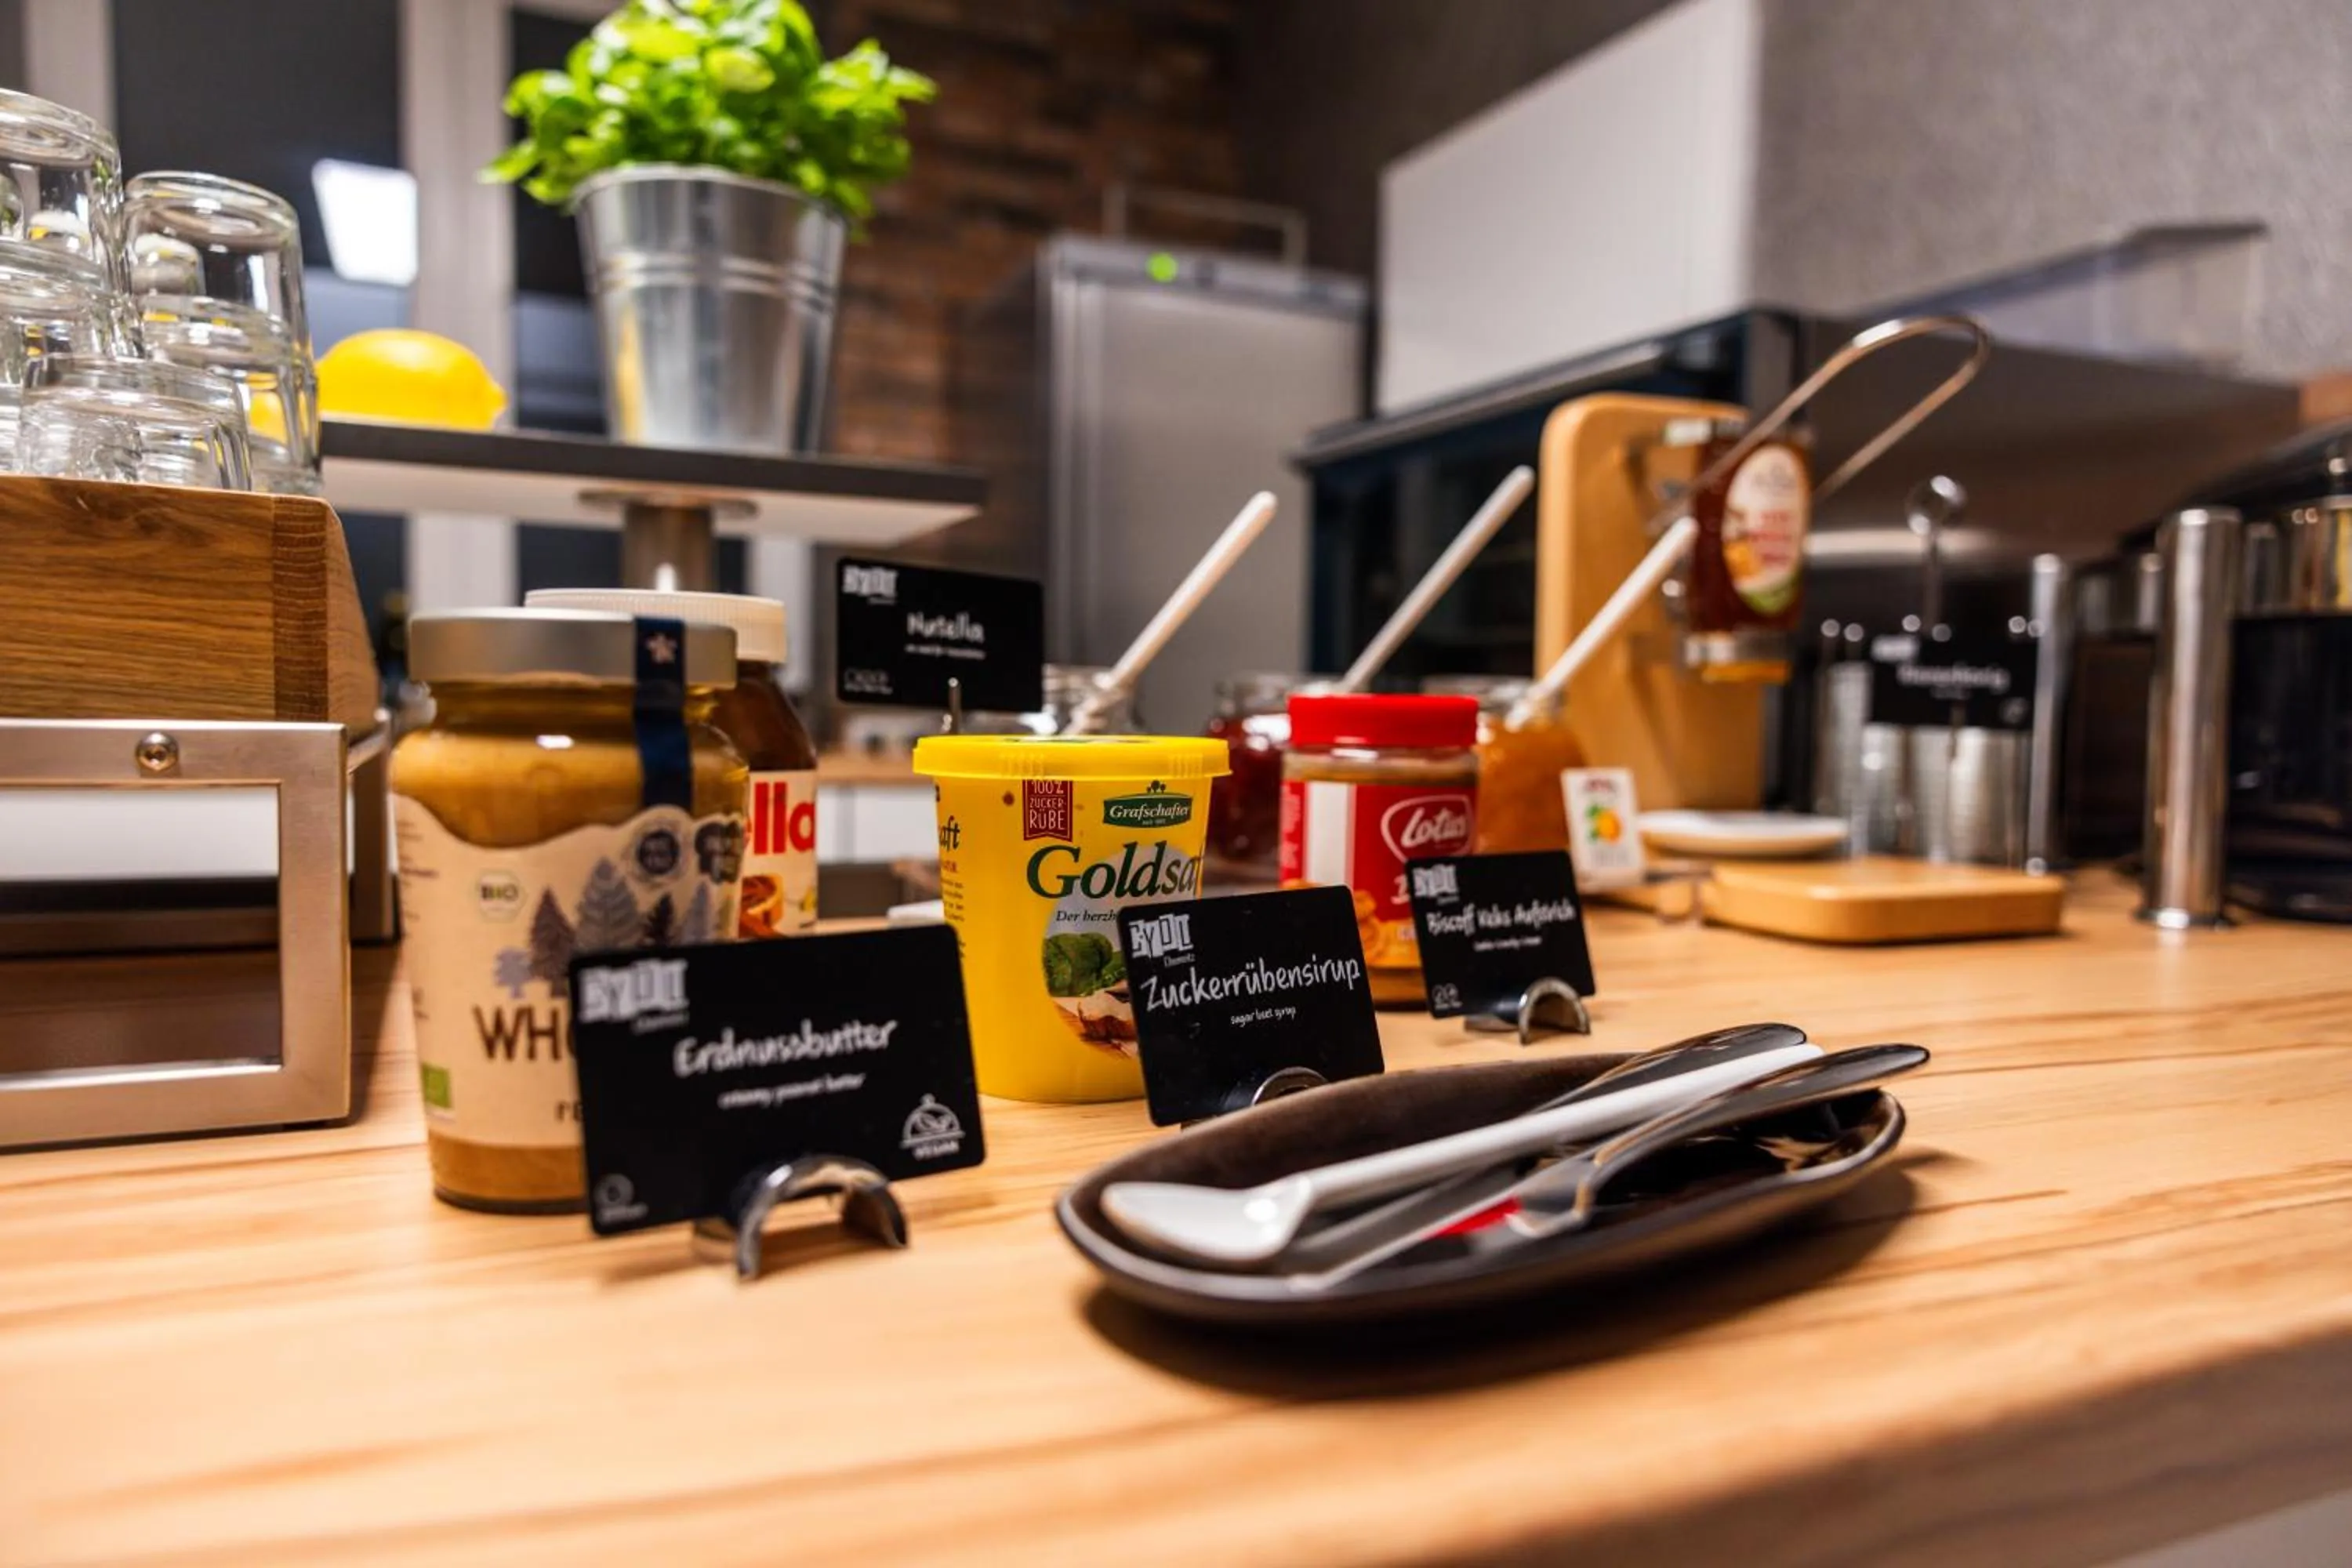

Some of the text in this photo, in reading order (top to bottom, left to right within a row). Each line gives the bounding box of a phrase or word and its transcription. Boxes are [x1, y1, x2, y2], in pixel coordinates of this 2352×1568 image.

[746, 782, 815, 854] lla
[1029, 808, 1065, 830] RÜBE
[1400, 807, 1466, 848] Lotus
[481, 885, 518, 900] BIO
[1057, 910, 1080, 921] Der
[1426, 903, 1475, 936] Biscoff
[1141, 953, 1360, 1012] Zuckerrübensirup
[472, 1003, 578, 1062] WH
[673, 1018, 898, 1078] Erdnussbutter
